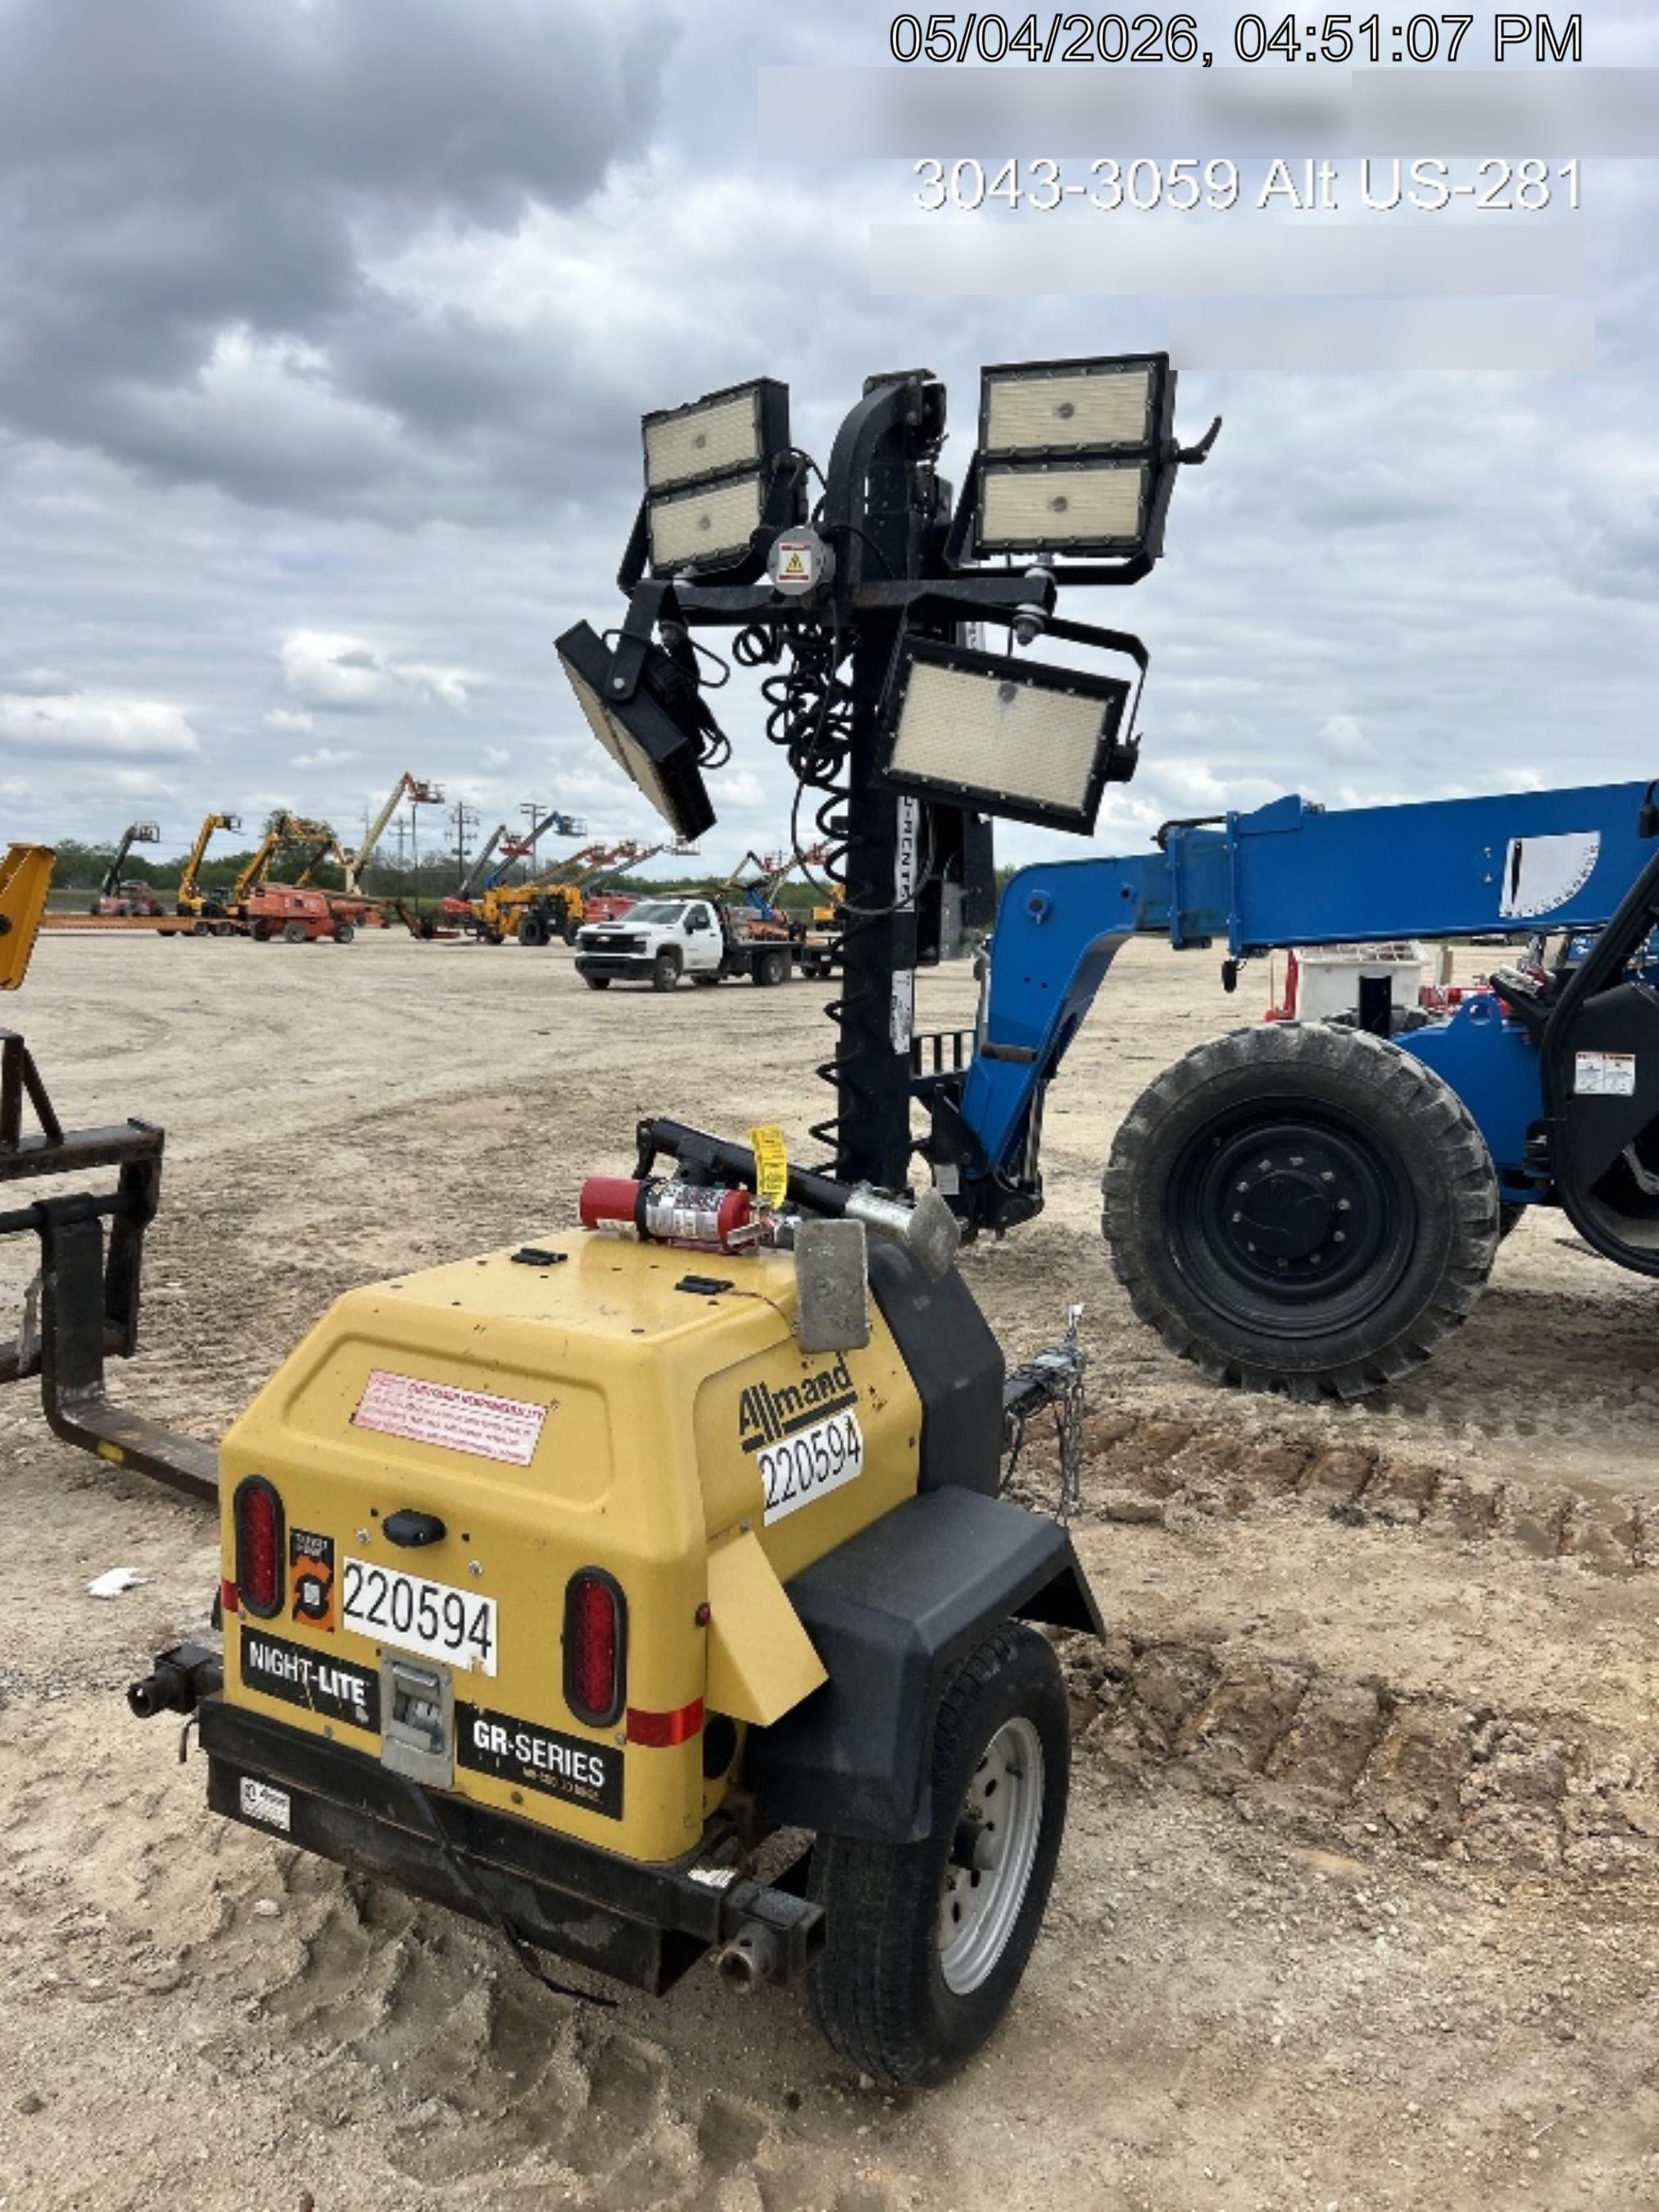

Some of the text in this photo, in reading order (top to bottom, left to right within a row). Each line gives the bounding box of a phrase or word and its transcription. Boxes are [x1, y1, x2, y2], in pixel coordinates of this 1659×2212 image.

[740, 1352, 854, 1443] Allmand
[759, 1415, 860, 1511] 220594
[343, 1563, 492, 1659] 220594
[250, 1641, 366, 1707] NIGHT-LITE
[473, 1720, 605, 1788] GR-SERIES
